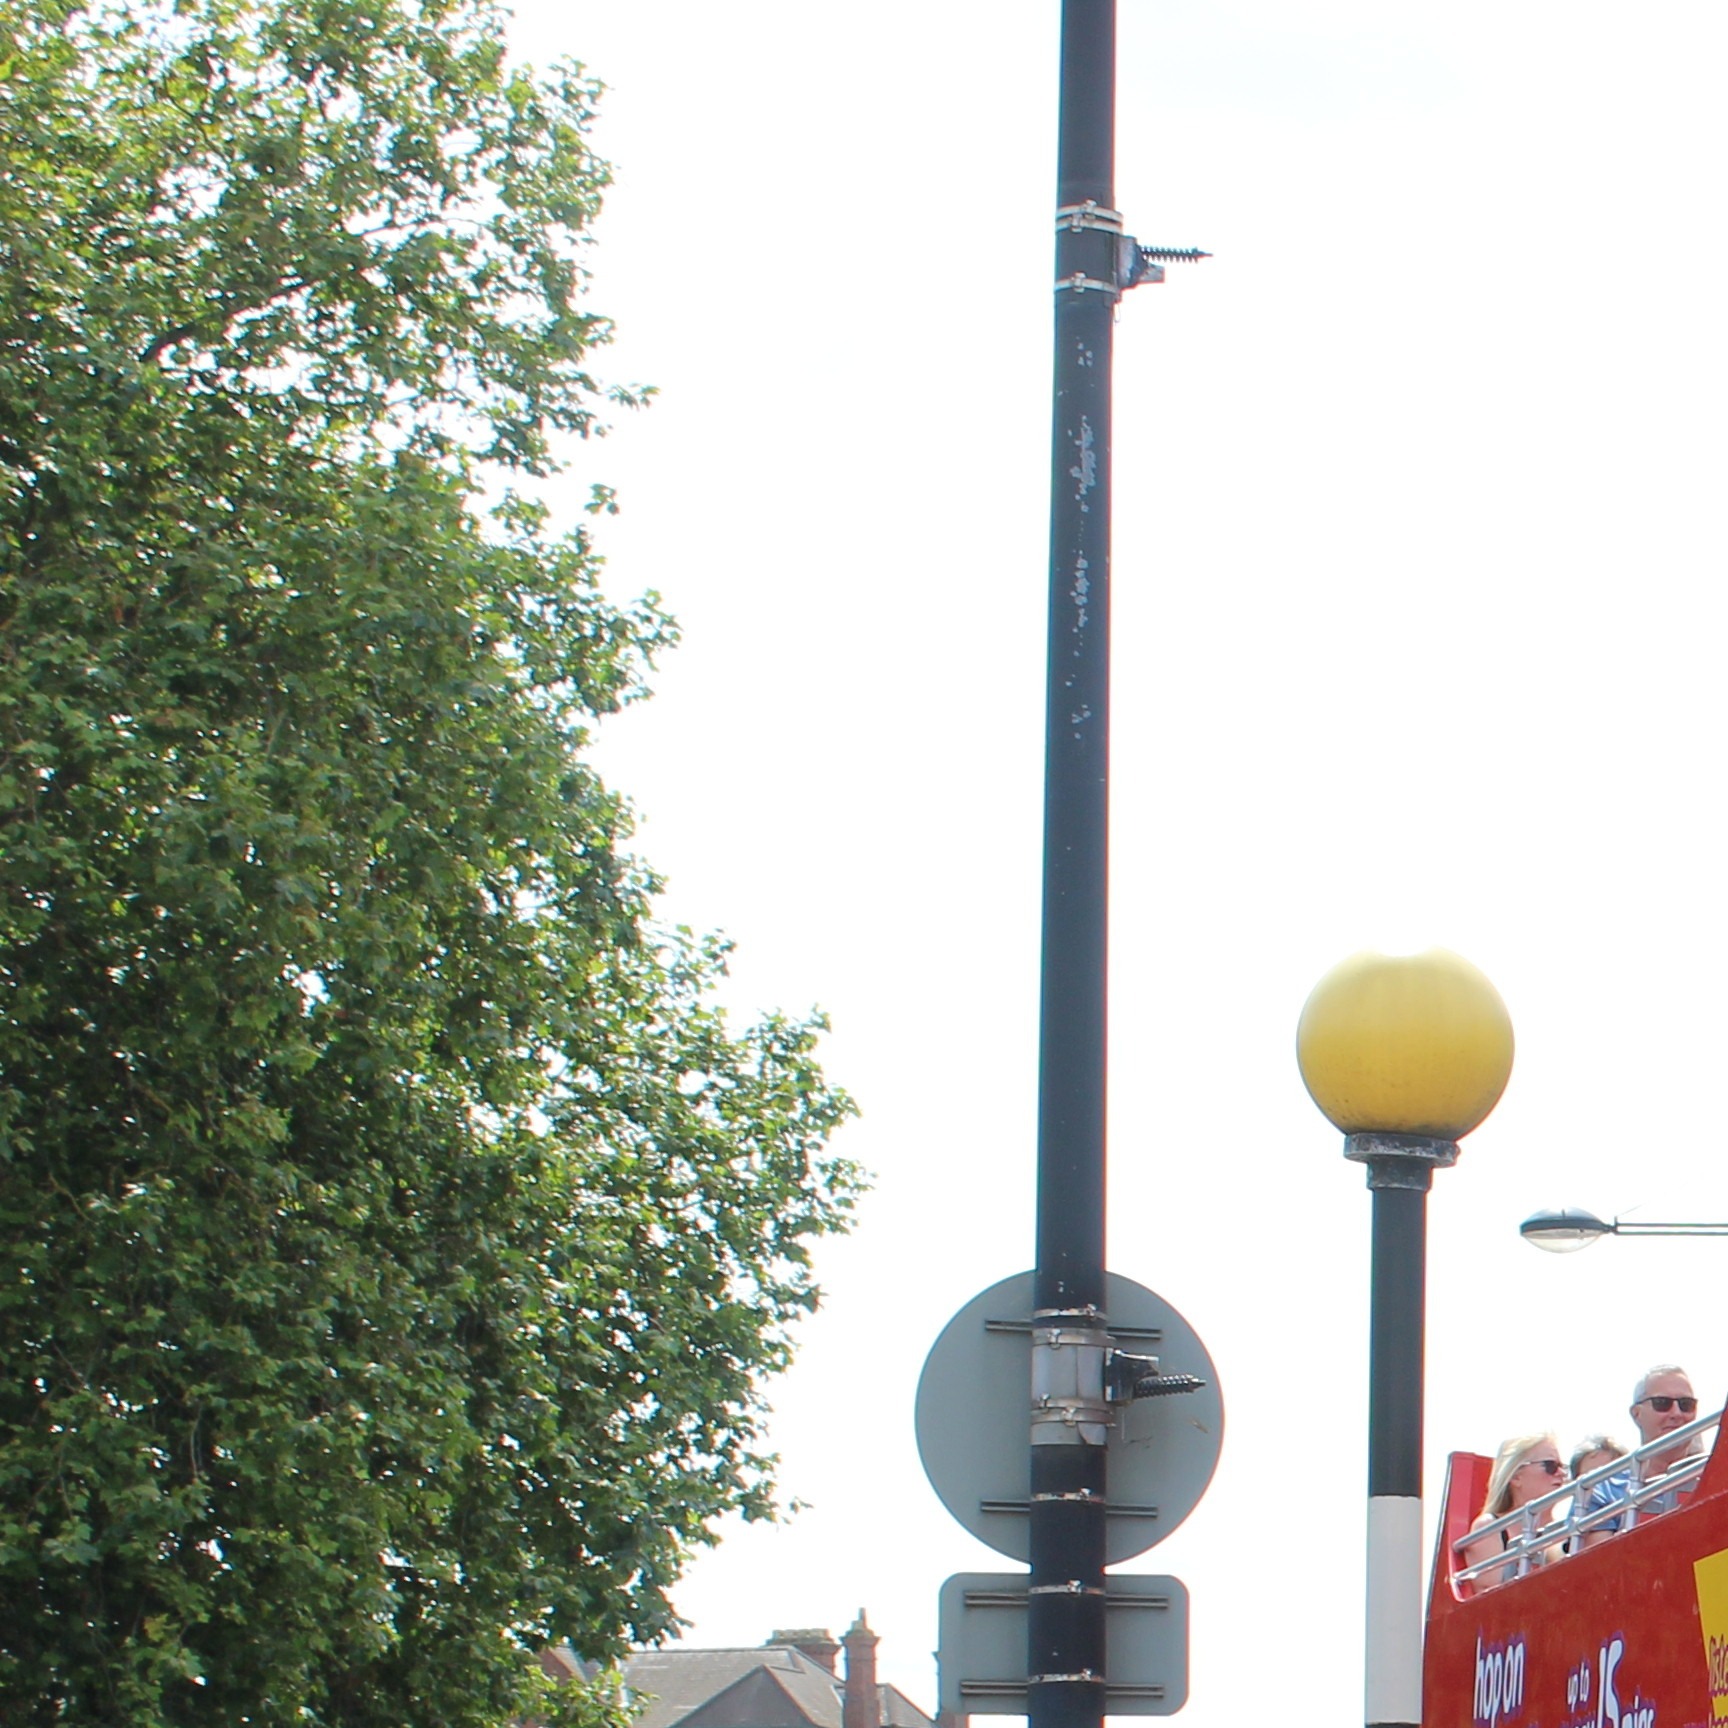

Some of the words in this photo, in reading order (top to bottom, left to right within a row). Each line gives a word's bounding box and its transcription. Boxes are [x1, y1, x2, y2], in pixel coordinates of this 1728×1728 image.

[1502, 1641, 1525, 1715] on
[1567, 1673, 1579, 1714] up
[1579, 1661, 1591, 1702] to
